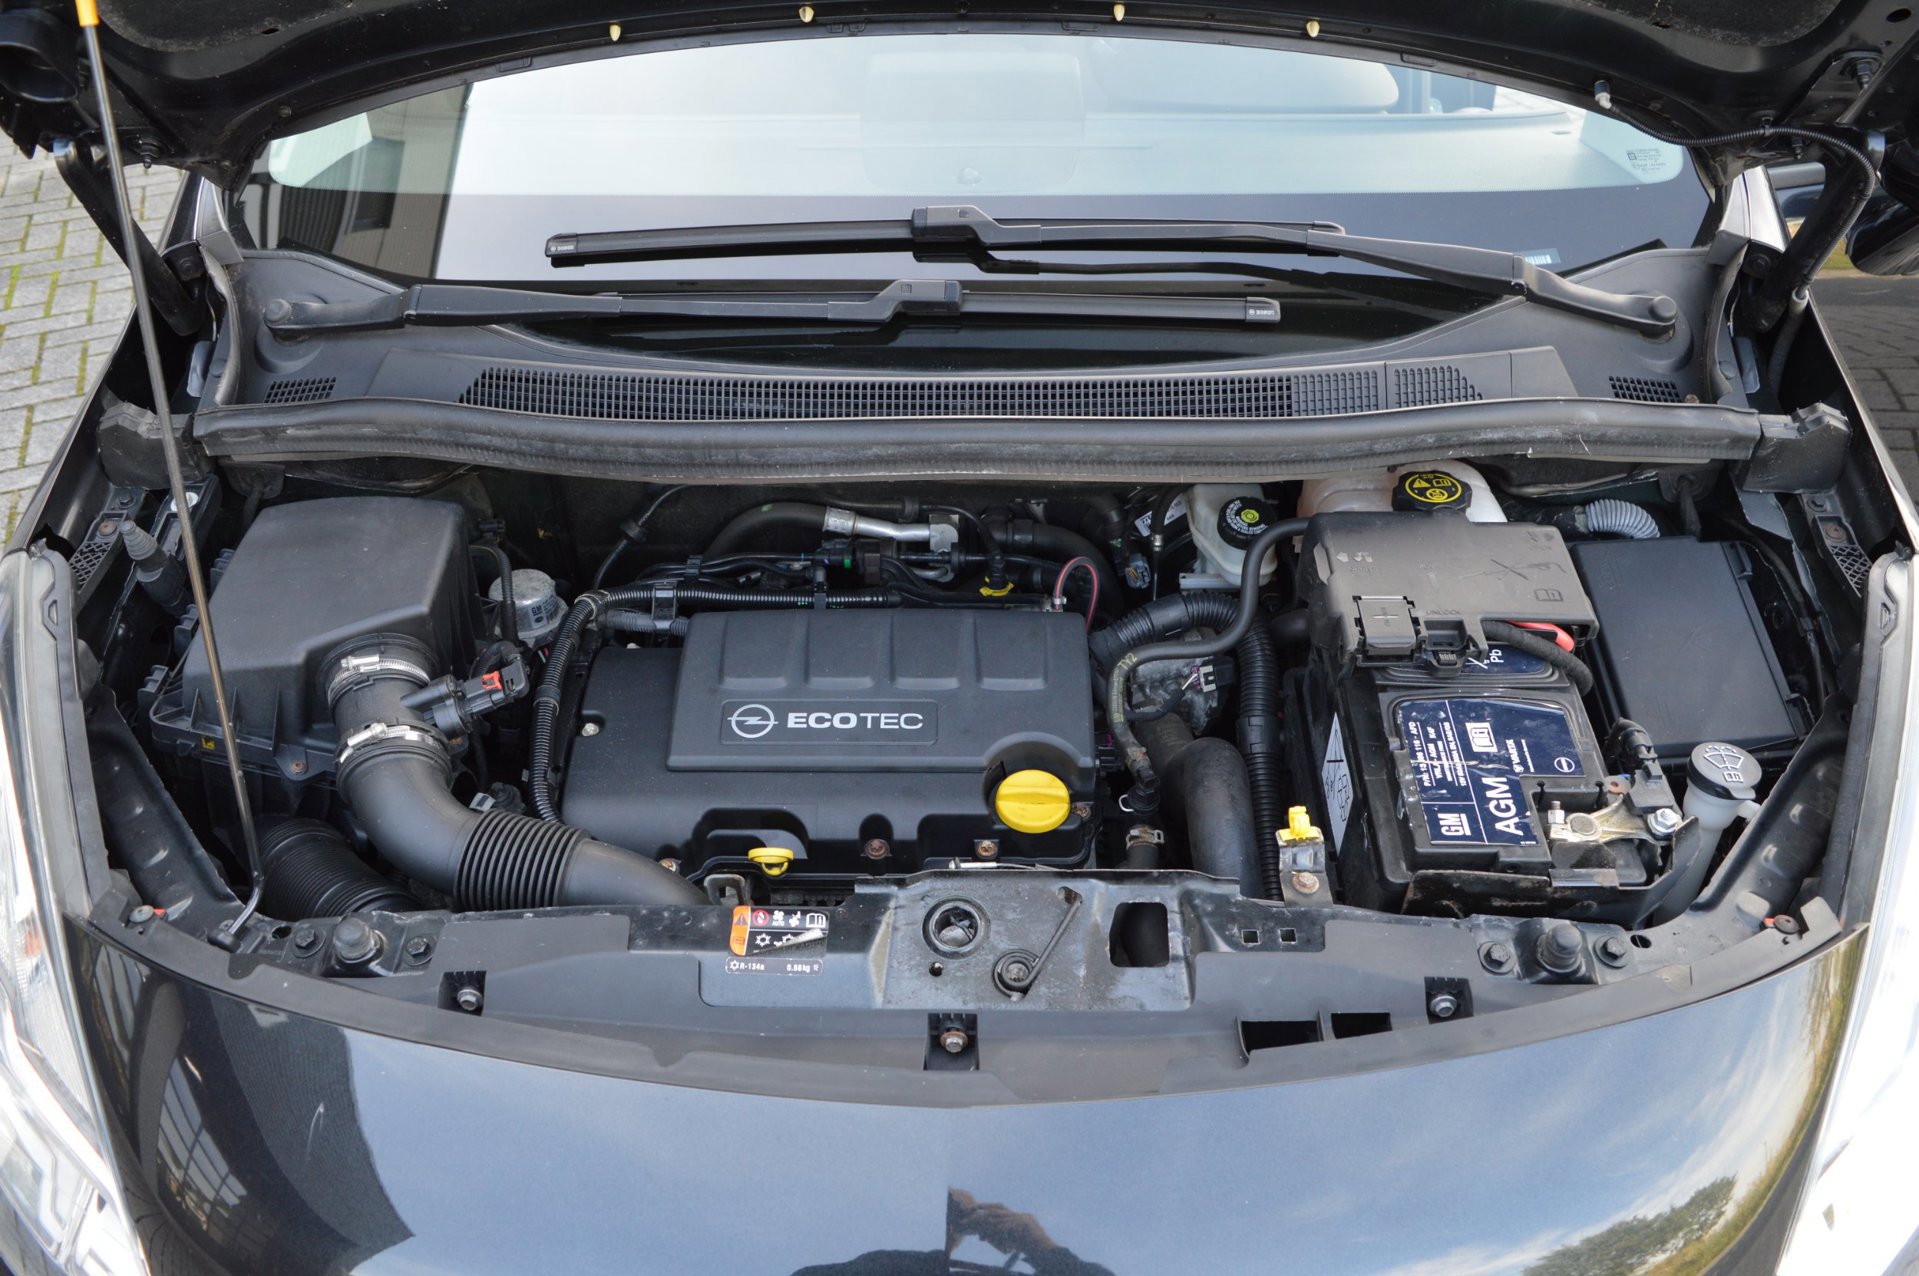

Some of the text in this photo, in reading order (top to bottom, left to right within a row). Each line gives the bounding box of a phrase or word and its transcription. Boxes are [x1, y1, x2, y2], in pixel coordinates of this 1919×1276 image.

[1489, 649, 1504, 663] Pb
[787, 712, 923, 730] ECOTEC
[1481, 777, 1524, 836] AGM
[1437, 813, 1465, 836] GM
